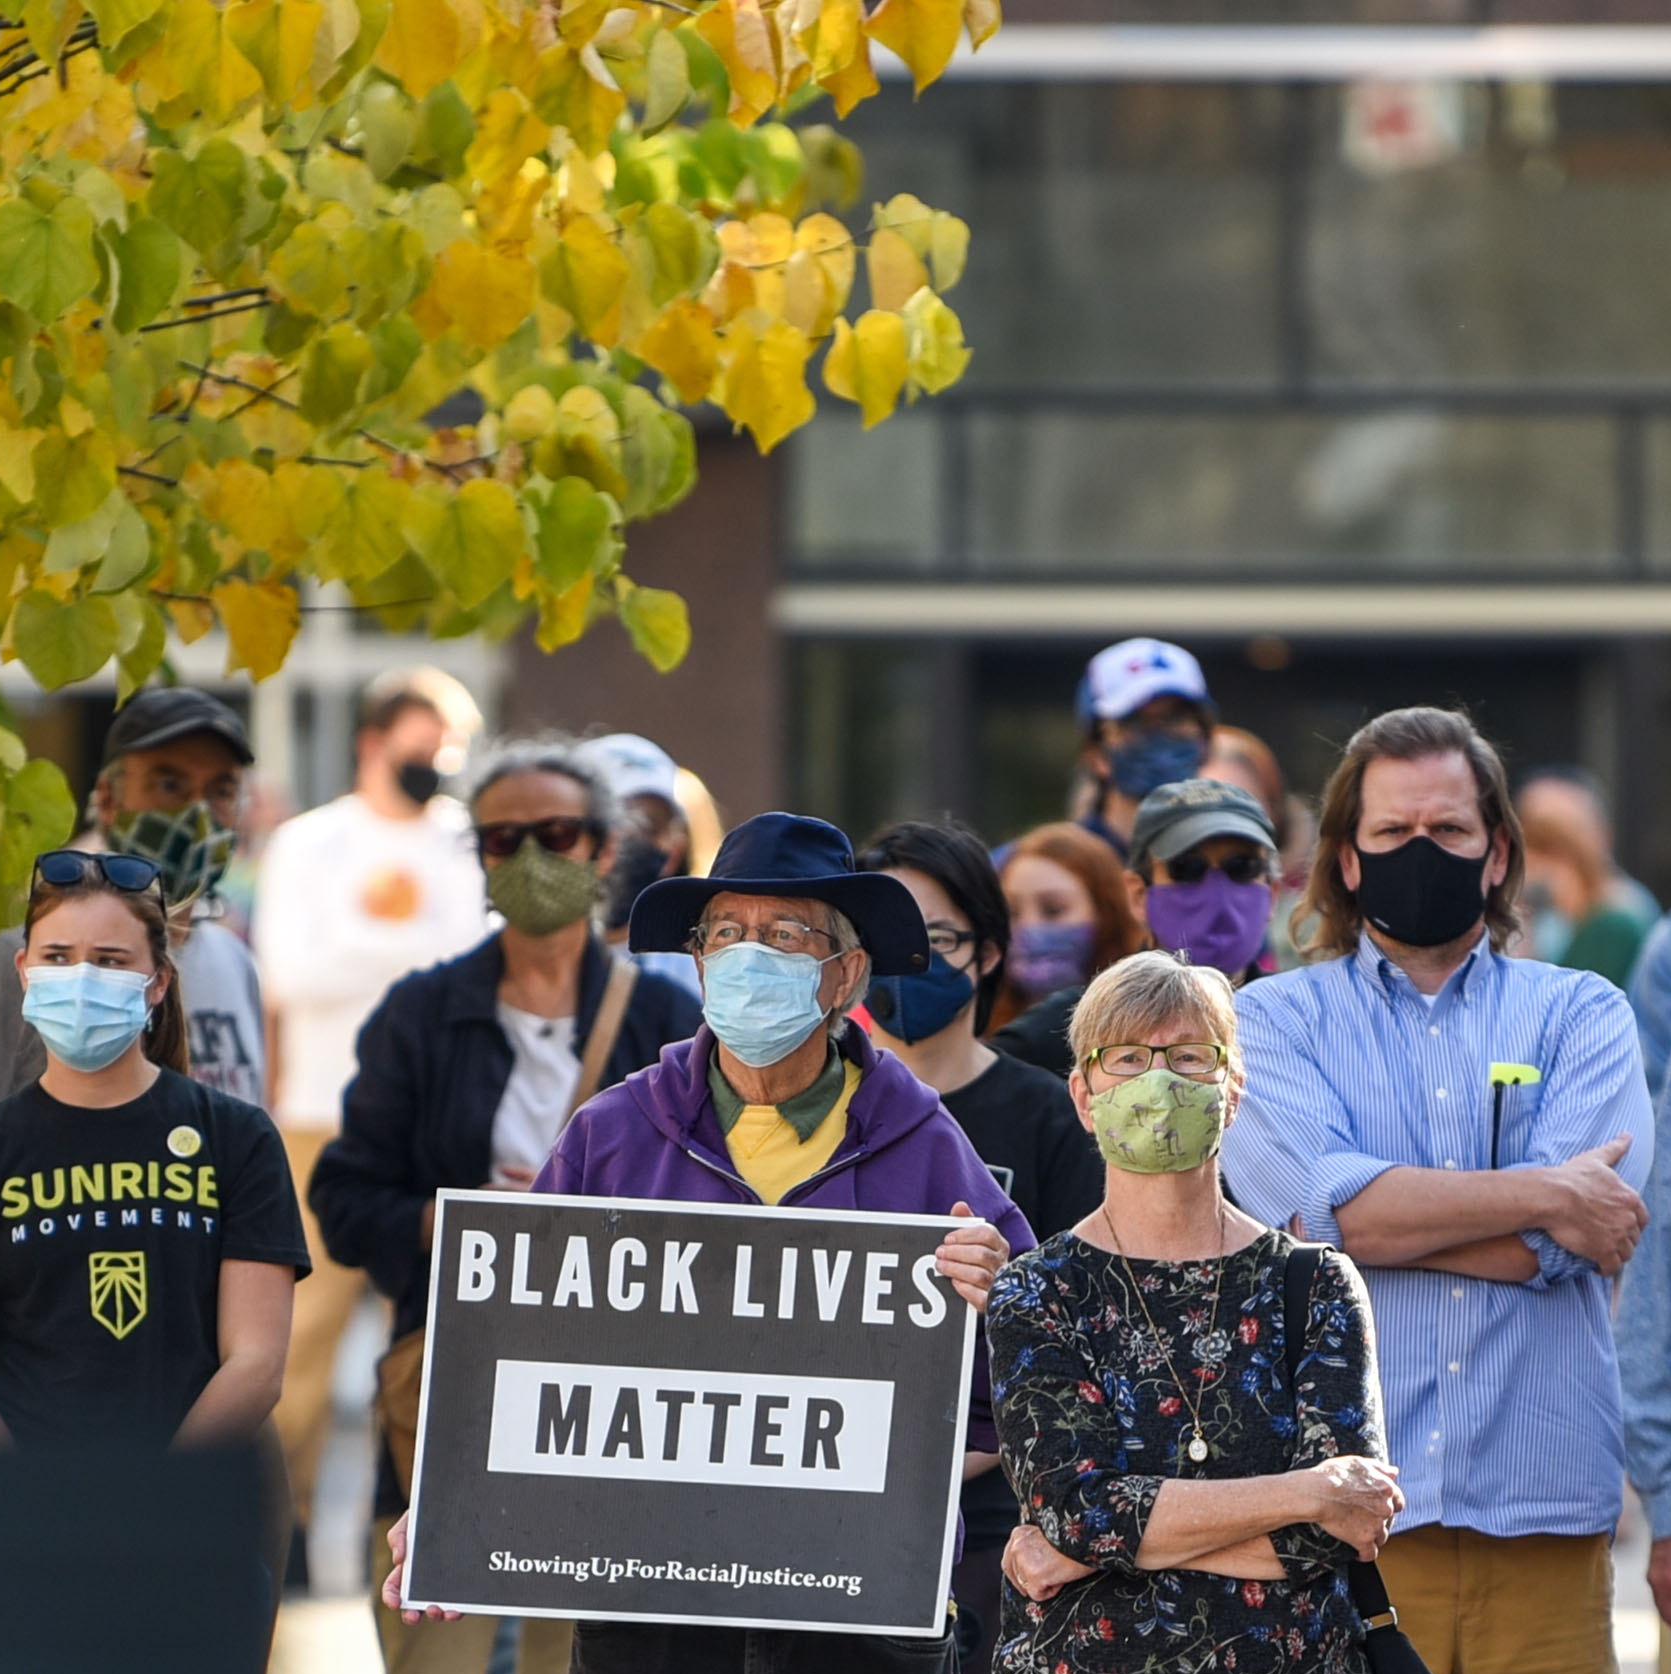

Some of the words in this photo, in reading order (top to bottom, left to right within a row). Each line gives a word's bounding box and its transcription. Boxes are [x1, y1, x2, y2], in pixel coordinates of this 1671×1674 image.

[1, 1161, 220, 1219] SUNRISE
[11, 1208, 215, 1243] MOVEMENT
[457, 1229, 703, 1315] BLACK
[732, 1244, 948, 1329] LIVES
[534, 1382, 846, 1470] MATTER
[488, 1551, 863, 1596] ShowingUpForRacialJustice.org
